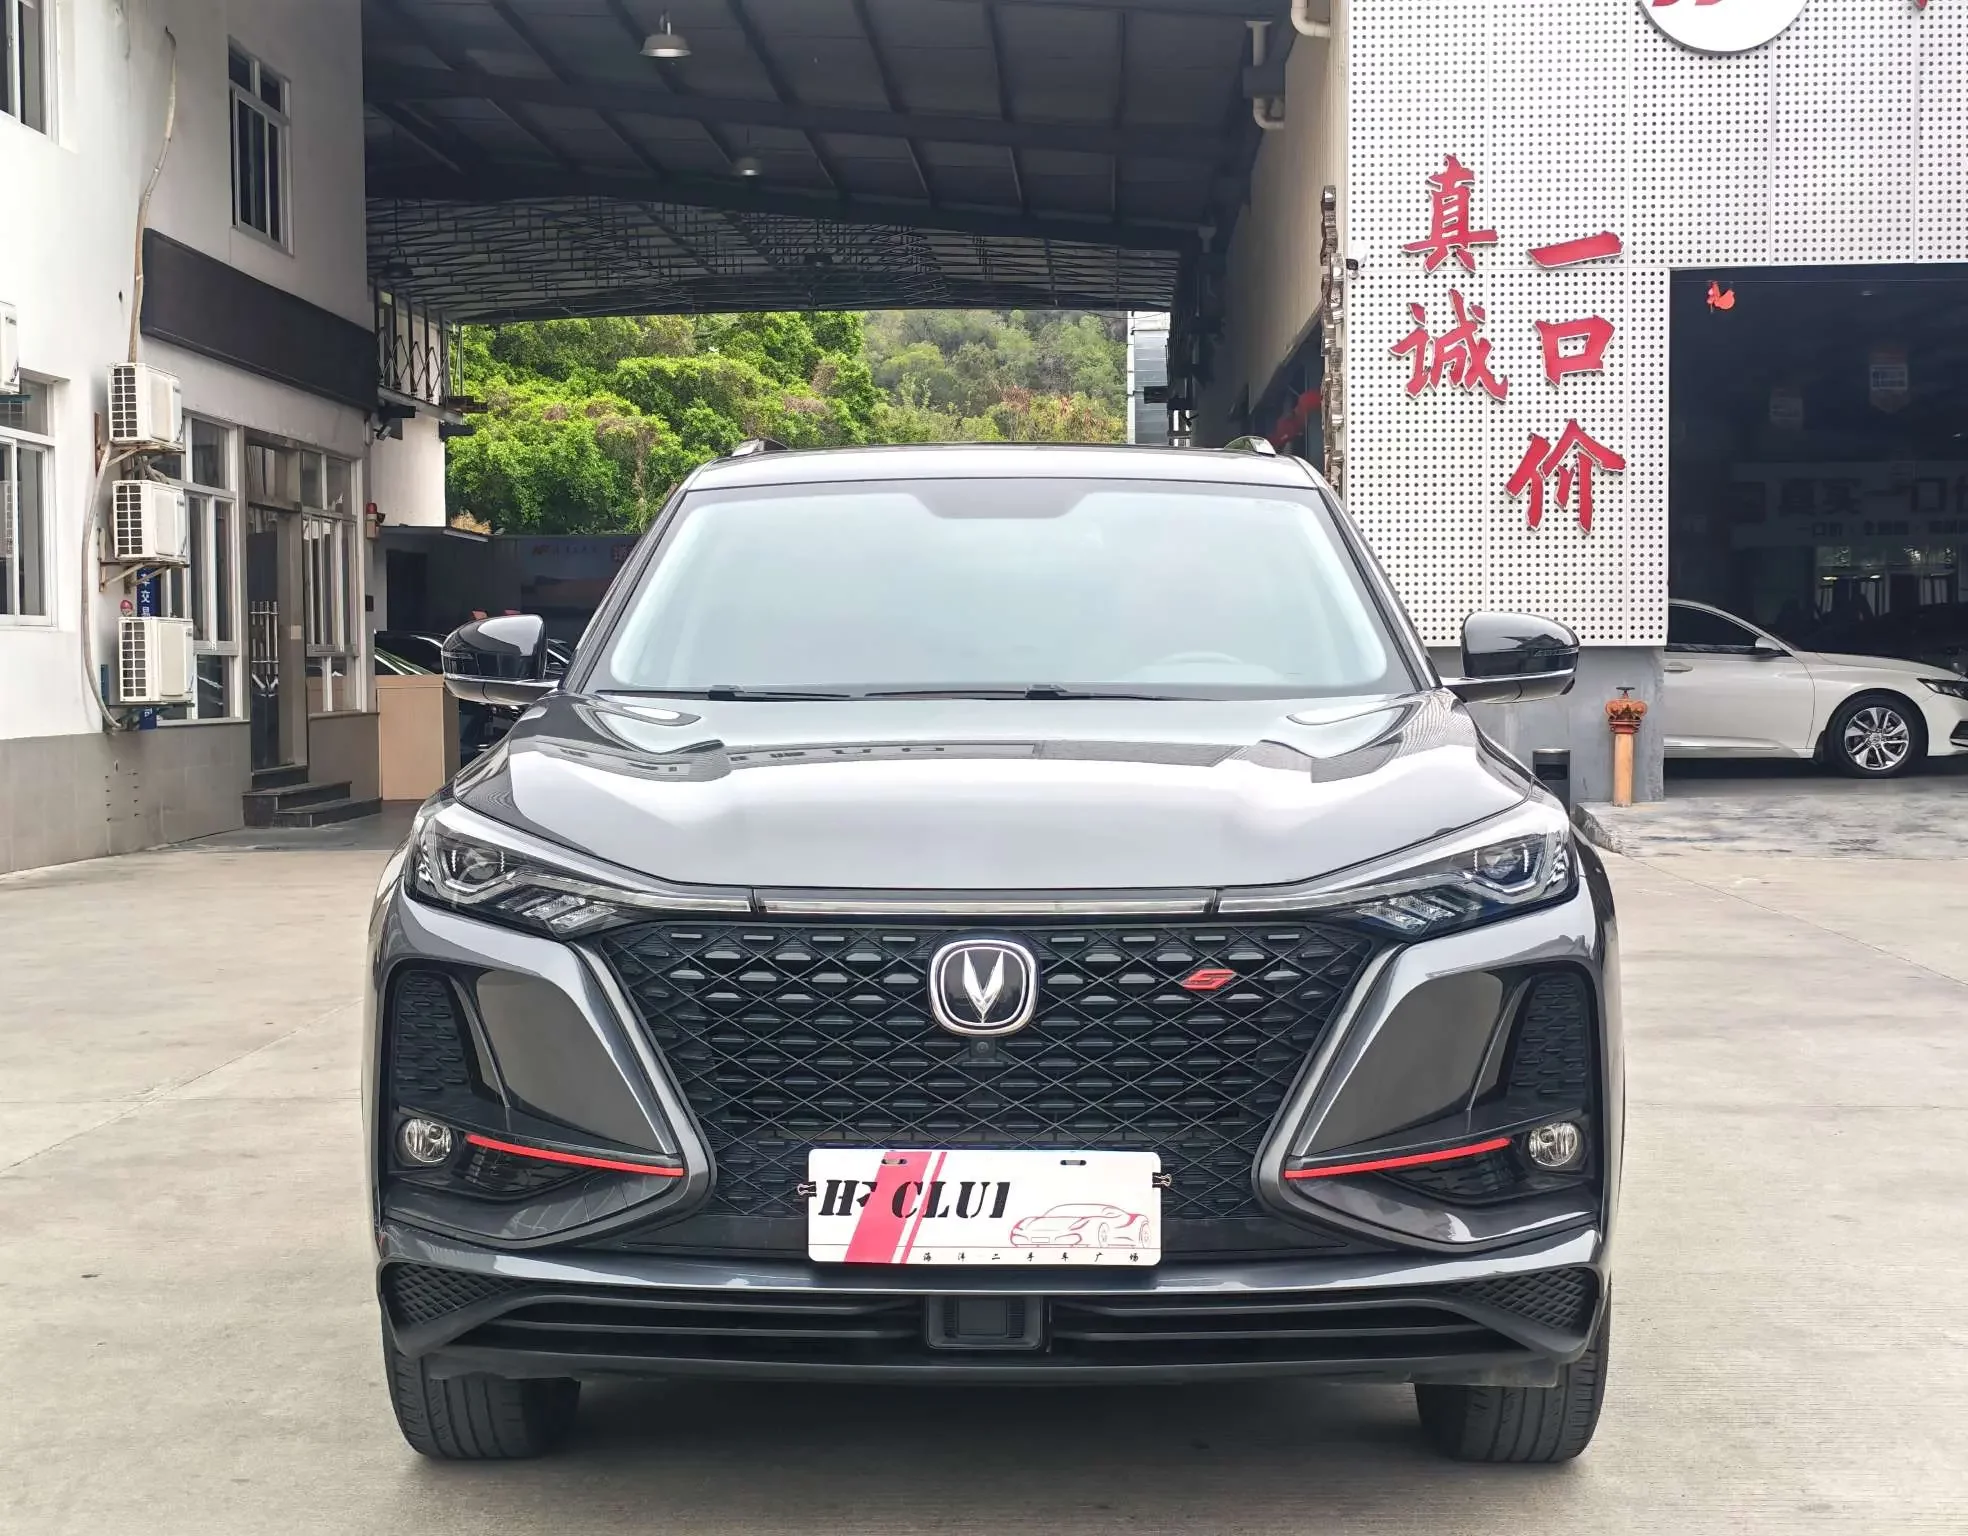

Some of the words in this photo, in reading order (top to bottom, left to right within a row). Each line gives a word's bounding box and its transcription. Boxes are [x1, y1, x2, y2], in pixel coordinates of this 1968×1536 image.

[1388, 153, 1509, 402] 真诚
[1504, 229, 1627, 534] 一口价
